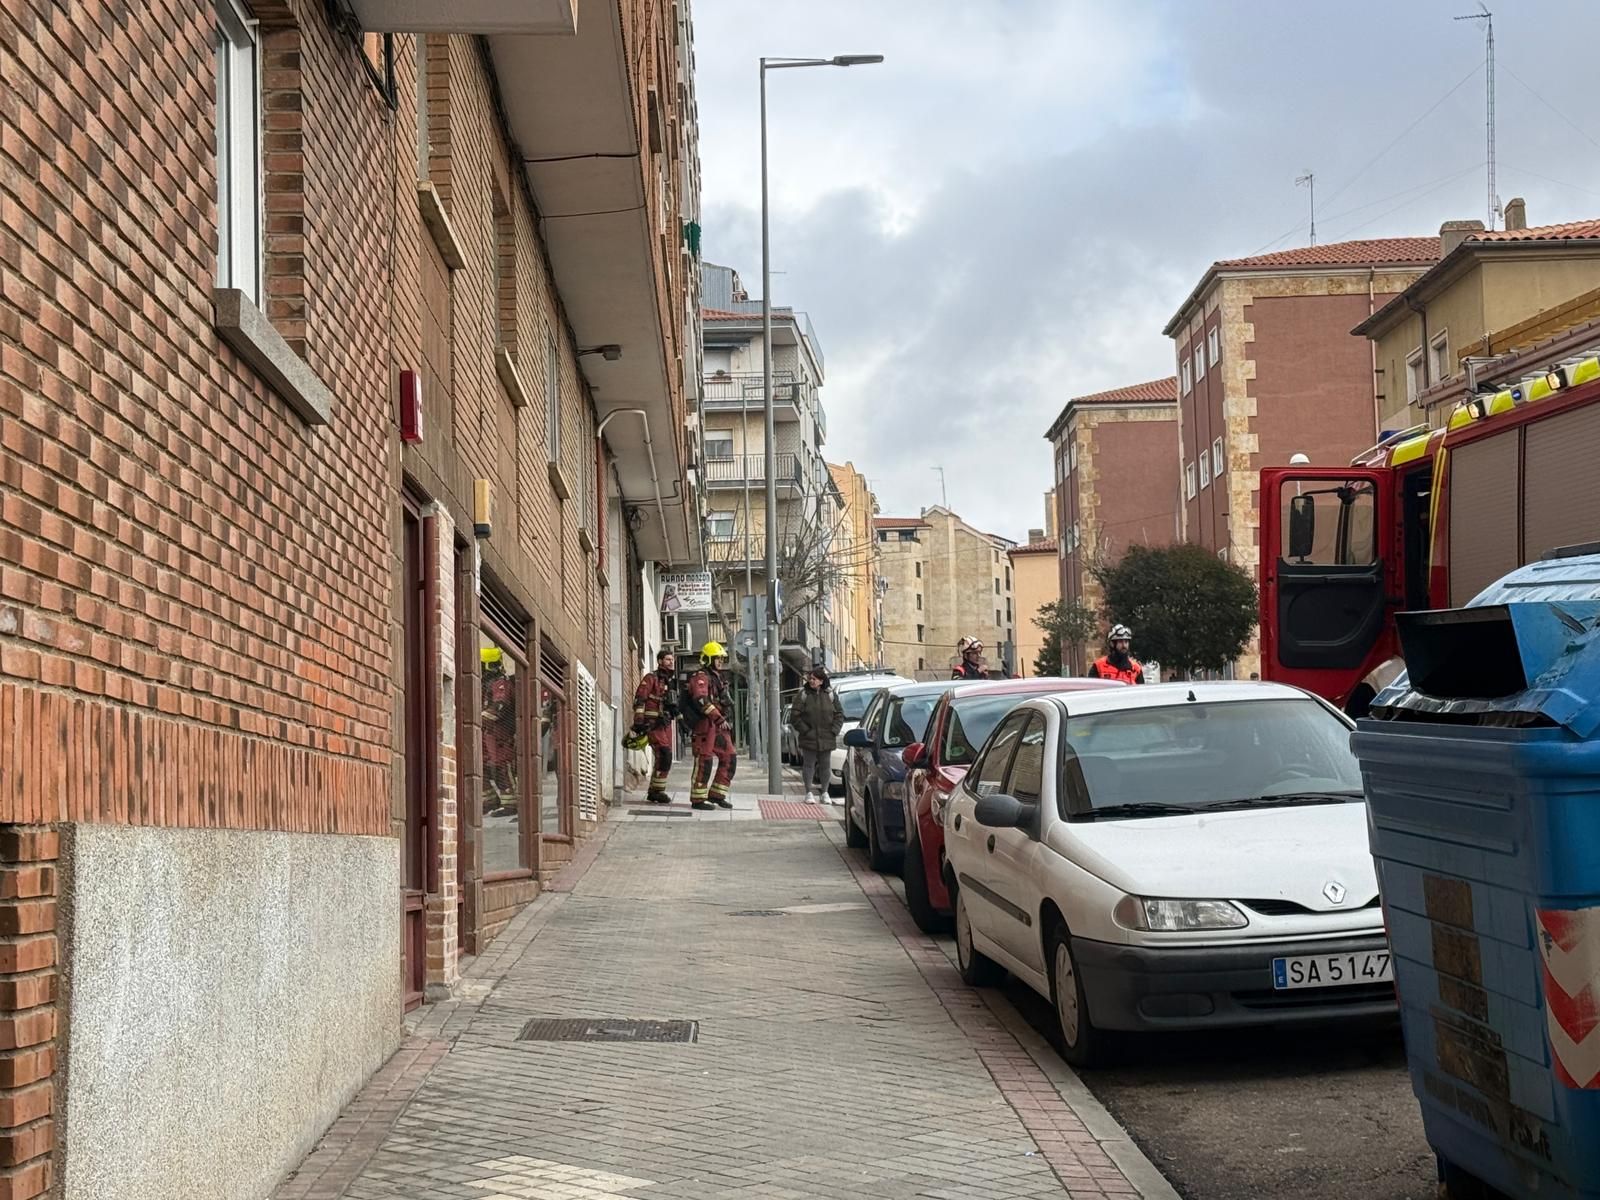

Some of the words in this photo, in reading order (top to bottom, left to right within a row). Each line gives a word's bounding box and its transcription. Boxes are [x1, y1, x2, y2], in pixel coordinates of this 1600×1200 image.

[661, 575, 685, 583] RUANO
[1290, 959, 1321, 984] SA
[1328, 954, 1390, 981] 5147
[1278, 976, 1285, 984] E
